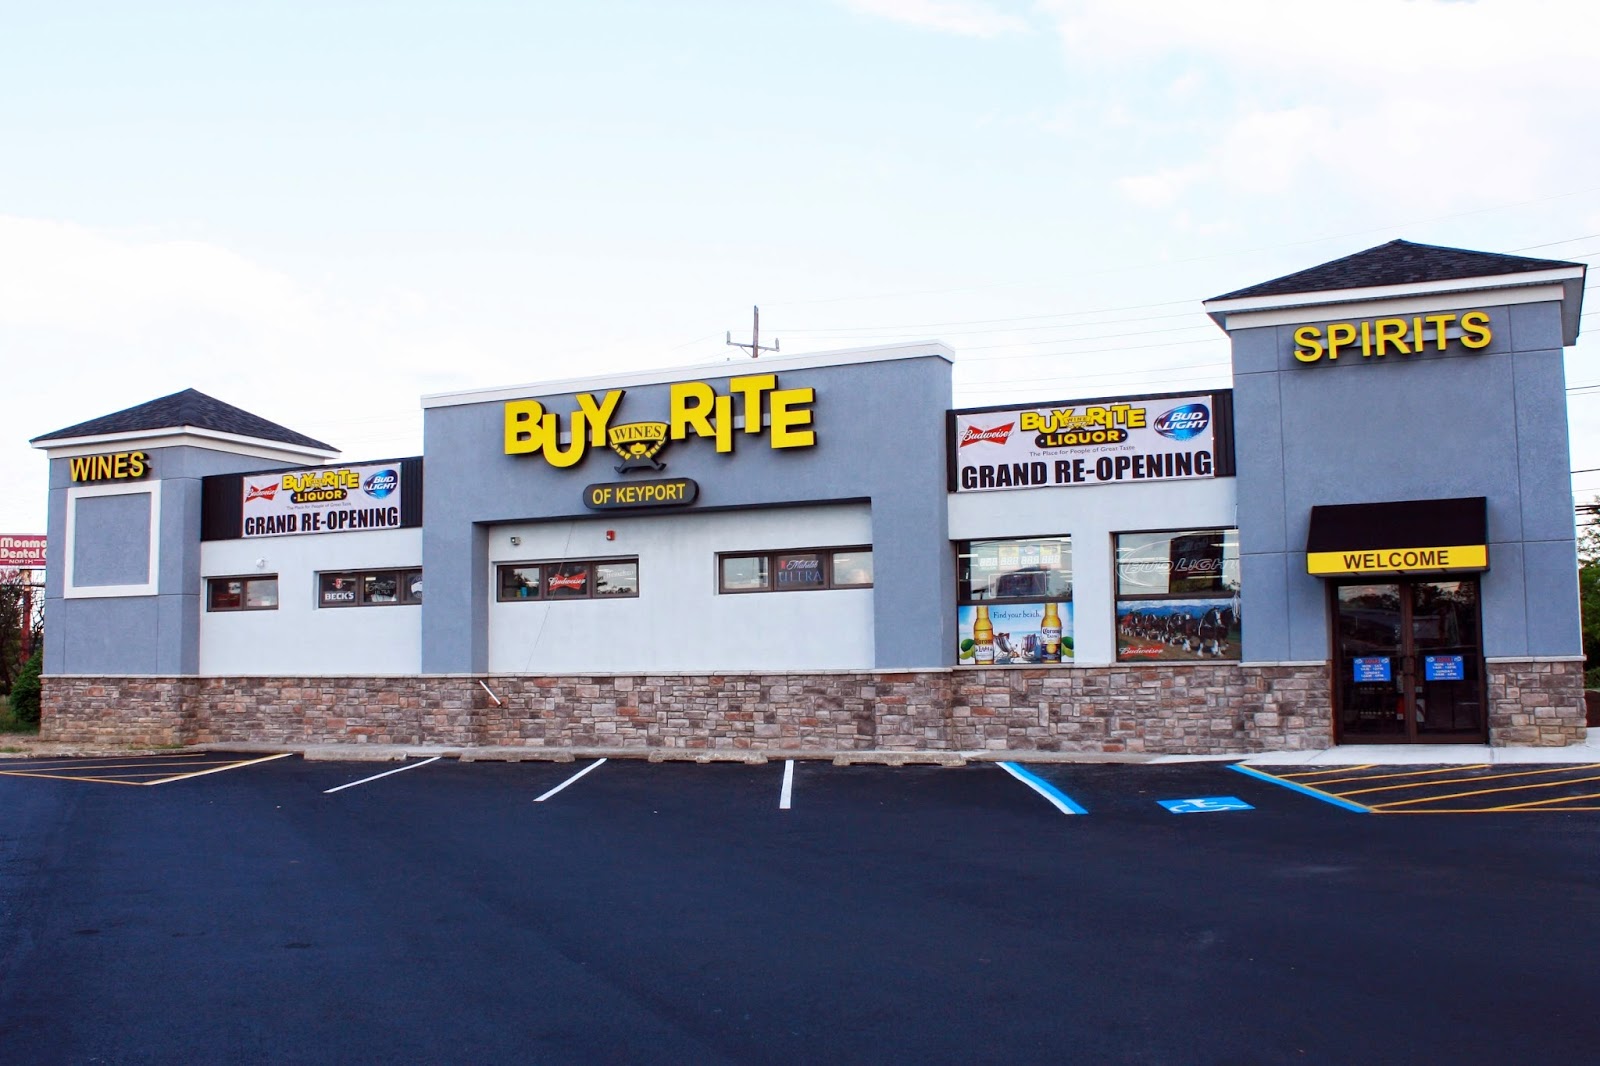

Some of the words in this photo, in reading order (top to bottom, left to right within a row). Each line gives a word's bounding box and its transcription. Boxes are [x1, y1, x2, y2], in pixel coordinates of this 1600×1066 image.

[1293, 311, 1492, 363] SPIRITS
[504, 389, 624, 468] BUY
[670, 374, 815, 453] RITE
[1020, 408, 1076, 434] BUY
[1086, 404, 1146, 430] RITE
[1169, 411, 1204, 421] BUD
[1162, 420, 1208, 430] LIGHT
[613, 424, 662, 441] WINES
[960, 428, 1014, 442] Budweiser
[1046, 430, 1120, 447] LIQUOR
[70, 451, 145, 482] WINES
[961, 461, 1048, 490] GRAND
[1055, 450, 1212, 484] RE-OPENING
[282, 472, 316, 493] BUY
[322, 469, 360, 490] RITE
[373, 475, 395, 484] BUD
[368, 483, 397, 491] LIGHT
[592, 488, 612, 505] OF
[616, 483, 686, 503] KEYPORT
[297, 490, 343, 502] LIQUOR
[244, 513, 298, 536] GRAND
[301, 506, 399, 532] RE-OPENING
[0, 548, 40, 559] Dental
[1343, 550, 1450, 569] WELCOME
[548, 576, 586, 587] Budweiser
[778, 570, 823, 582] ULTRA
[325, 591, 354, 601] BECK'S
[993, 611, 1007, 619] Find
[1022, 610, 1042, 618] beach.
[1119, 647, 1164, 655] Budweiser
